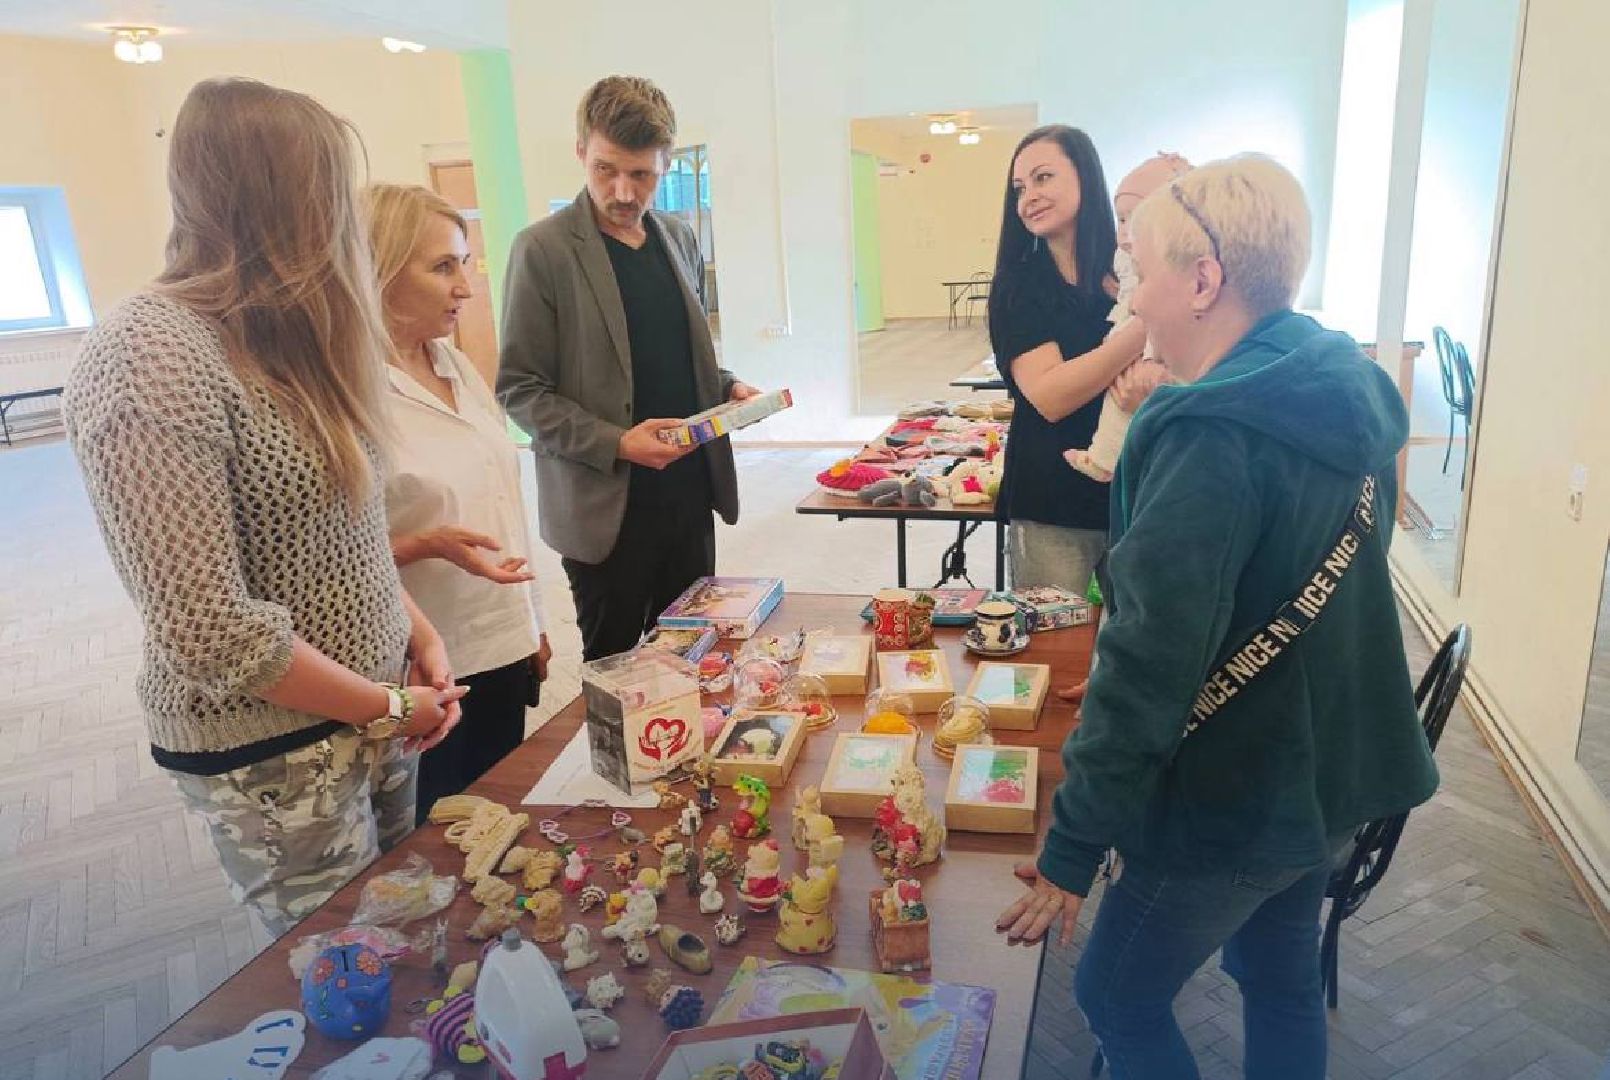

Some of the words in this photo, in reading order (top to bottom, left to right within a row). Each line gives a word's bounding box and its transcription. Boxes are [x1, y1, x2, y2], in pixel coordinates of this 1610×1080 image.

[1193, 671, 1238, 720] NICE
[1225, 633, 1281, 684] NICE
[1325, 532, 1360, 577] NIC
